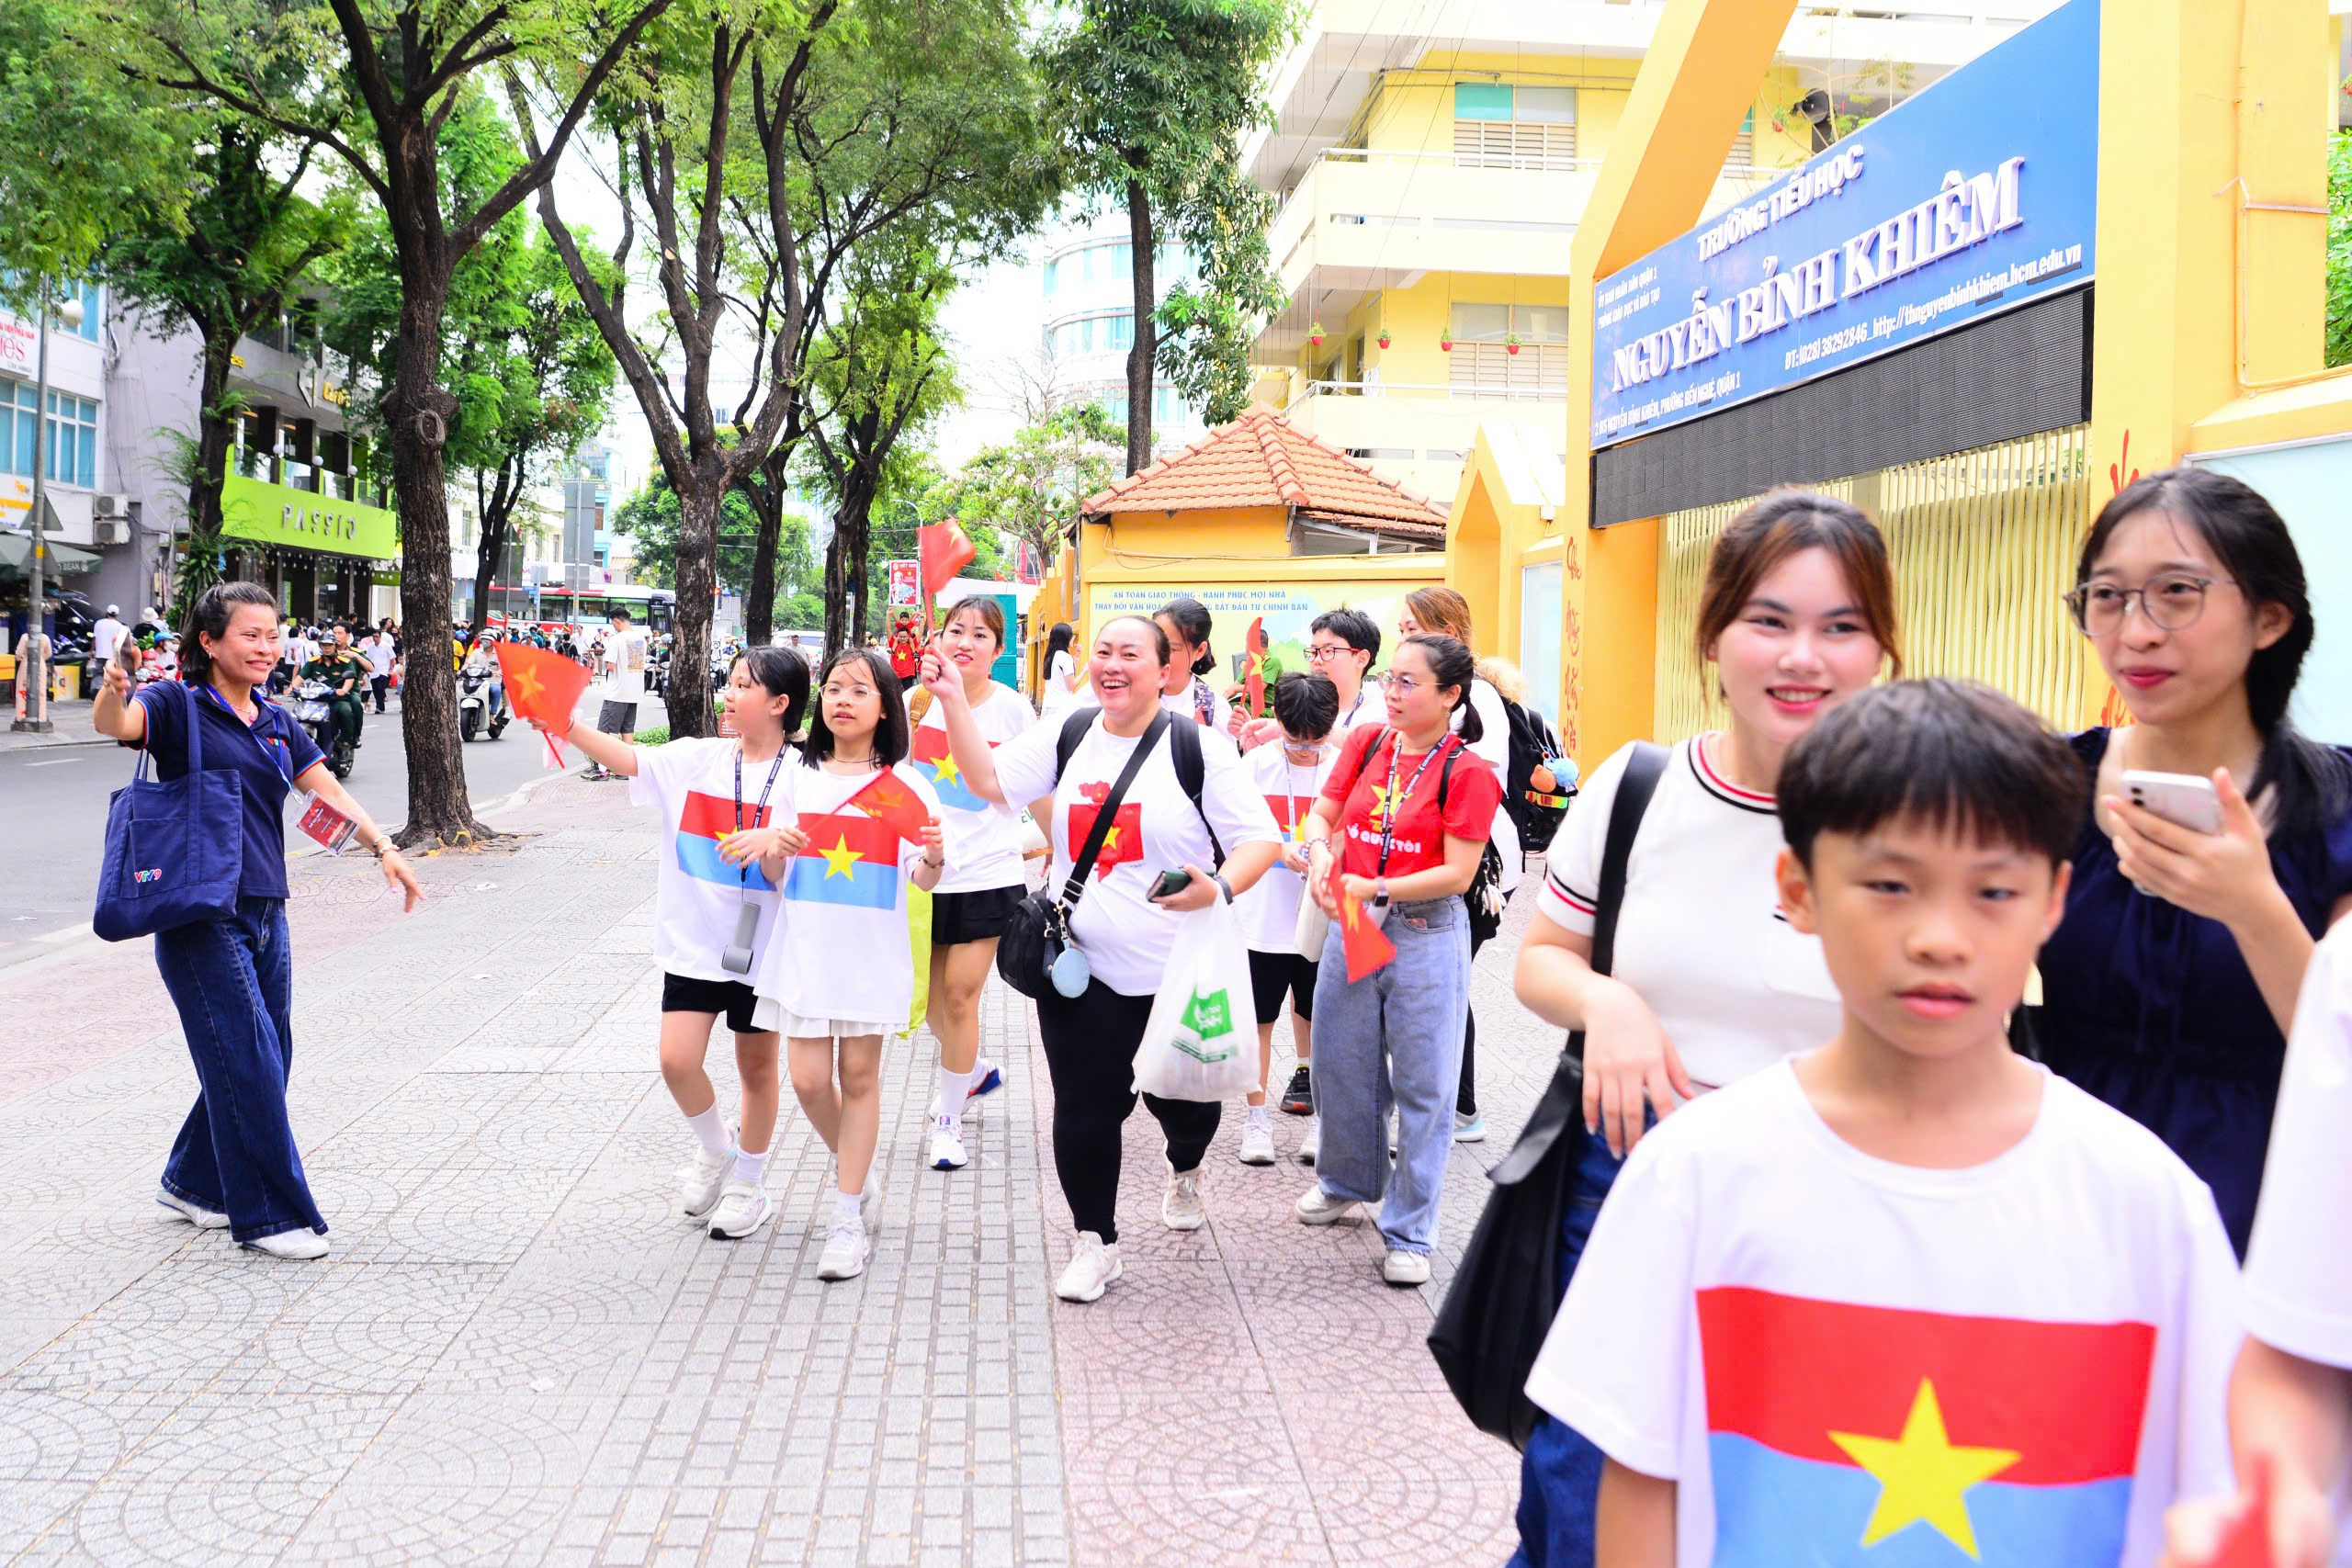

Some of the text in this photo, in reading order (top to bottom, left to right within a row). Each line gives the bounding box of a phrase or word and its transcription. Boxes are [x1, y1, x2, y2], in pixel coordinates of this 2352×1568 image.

[1697, 144, 1864, 263] TRƯỜNG TIỂU HỌC
[1611, 156, 2025, 393] NGUYỄN BỈNH KHIÊM
[1799, 341, 1821, 367] (028)
[281, 502, 356, 540] PASSIO
[1114, 591, 1124, 599] AN
[1148, 591, 1167, 599] GIAO
